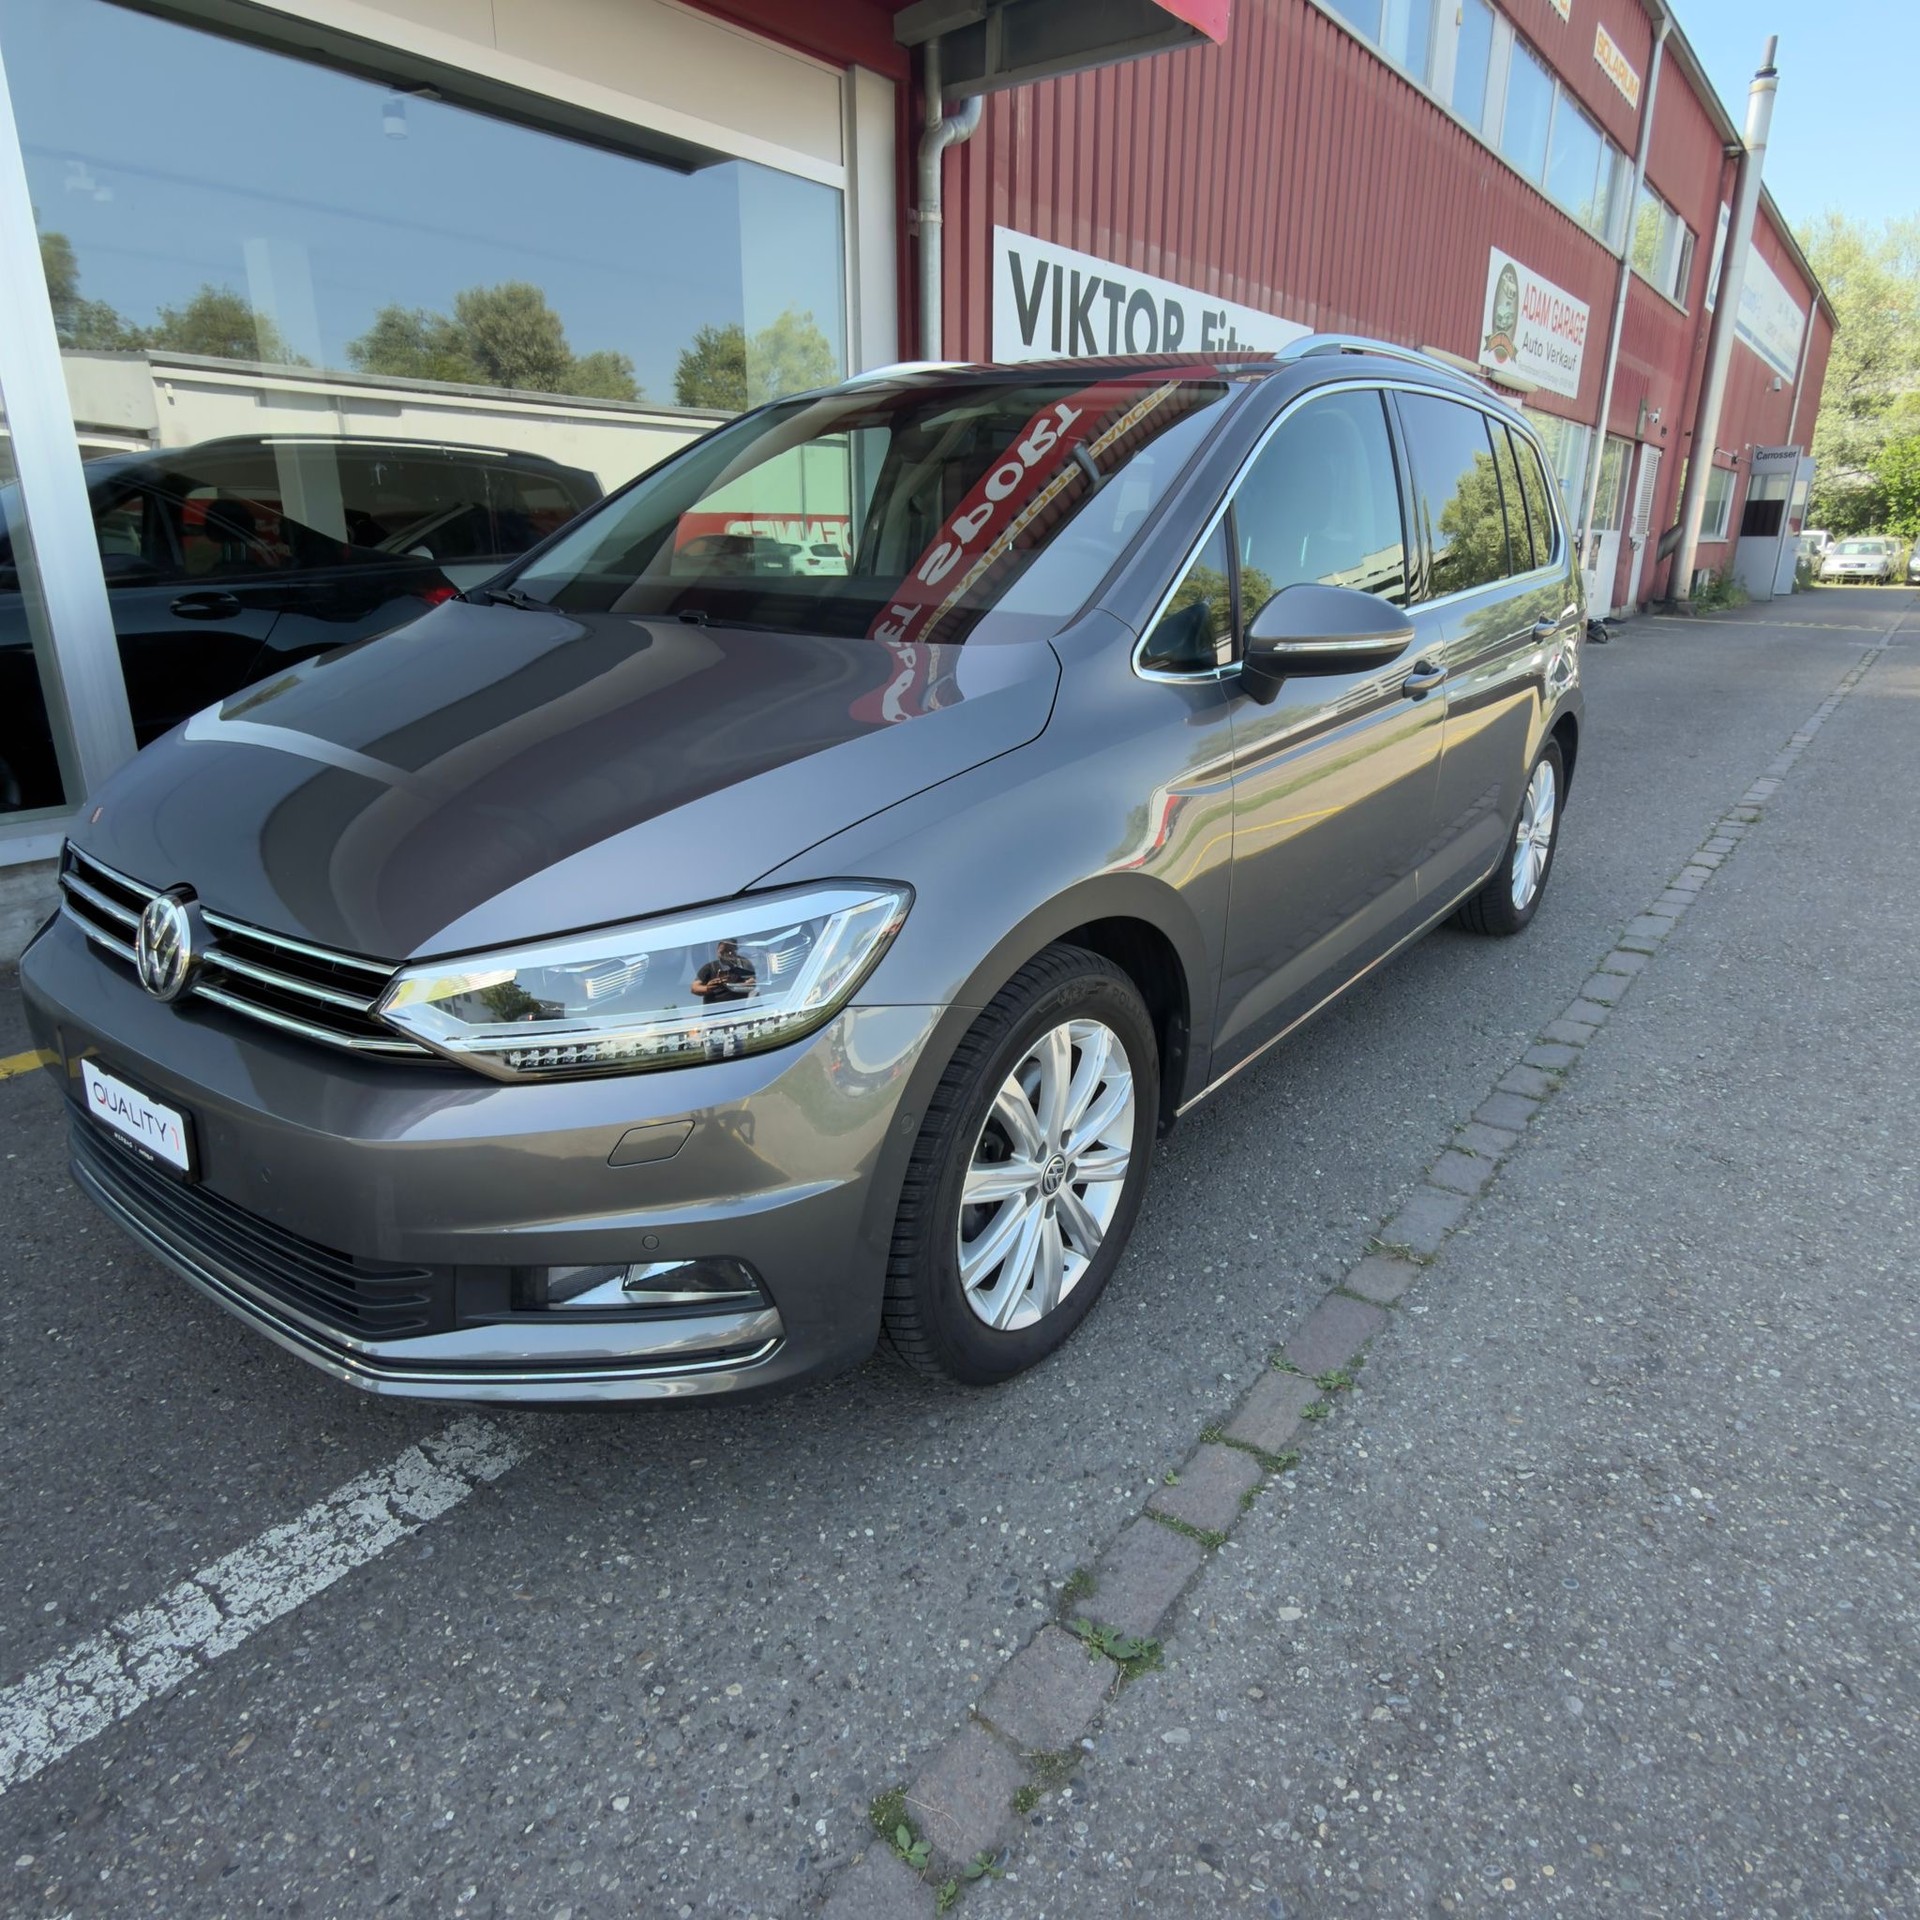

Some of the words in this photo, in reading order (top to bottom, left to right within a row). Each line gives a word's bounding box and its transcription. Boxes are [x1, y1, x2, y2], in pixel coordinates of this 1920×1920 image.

[1008, 250, 1185, 357] VIKTOR
[1522, 283, 1551, 329] ADAM
[1551, 299, 1586, 346] GARAGE
[1522, 331, 1543, 358] Auto
[1546, 341, 1578, 372] Verkauf
